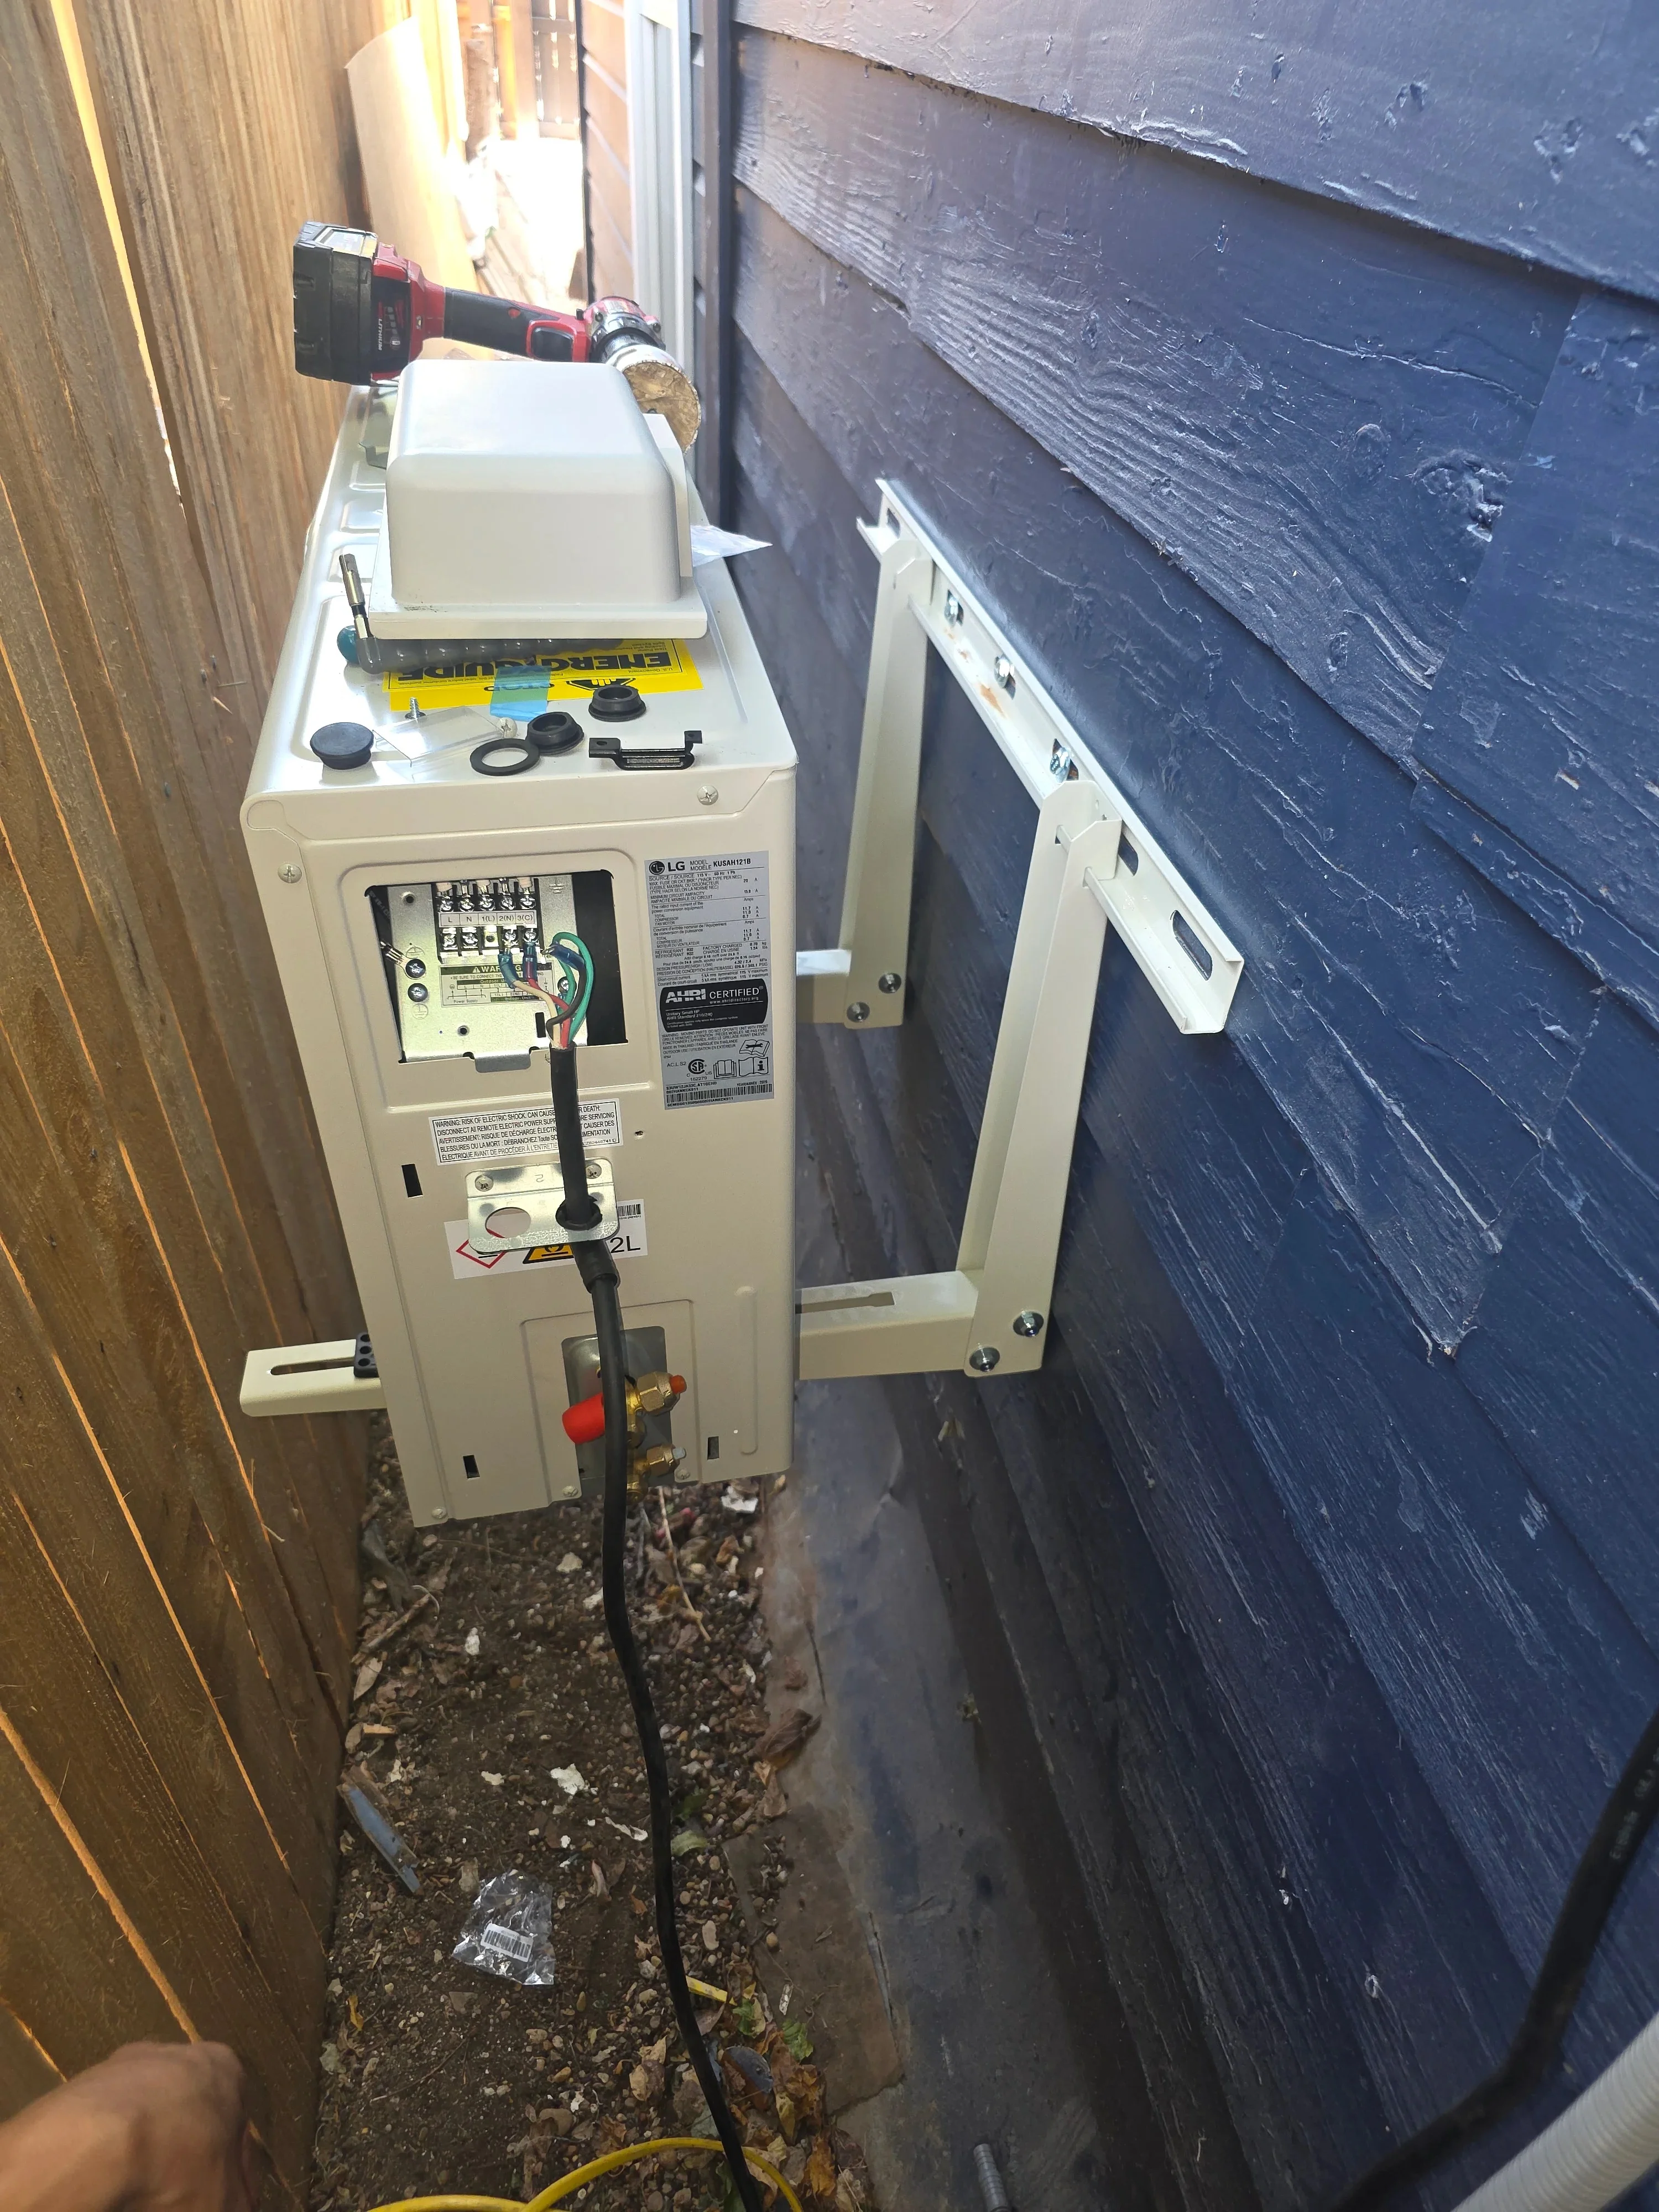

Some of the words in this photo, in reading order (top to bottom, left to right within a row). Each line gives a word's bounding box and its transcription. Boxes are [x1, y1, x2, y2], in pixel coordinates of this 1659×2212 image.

[667, 861, 685, 872] LG
[713, 858, 751, 867] KUSAH121B
[481, 964, 521, 973] WARG
[665, 988, 706, 1003] AHRI
[709, 987, 759, 999] CERTIFIED
[482, 1114, 507, 1123] ELECTRIC
[437, 1127, 469, 1136] DISCONNECT
[508, 1127, 537, 1136] DÉCHARGE
[537, 1125, 557, 1133] ÉLECTR
[440, 1144, 470, 1152] BLESSURES
[503, 1135, 537, 1145] DÉBRANCHEZ
[441, 1150, 473, 1160] ÉLECTRIQUE
[498, 1145, 525, 1154] PROCÉDER
[530, 1142, 557, 1150] L'ENTRETIE
[609, 1235, 640, 1254] 2L
